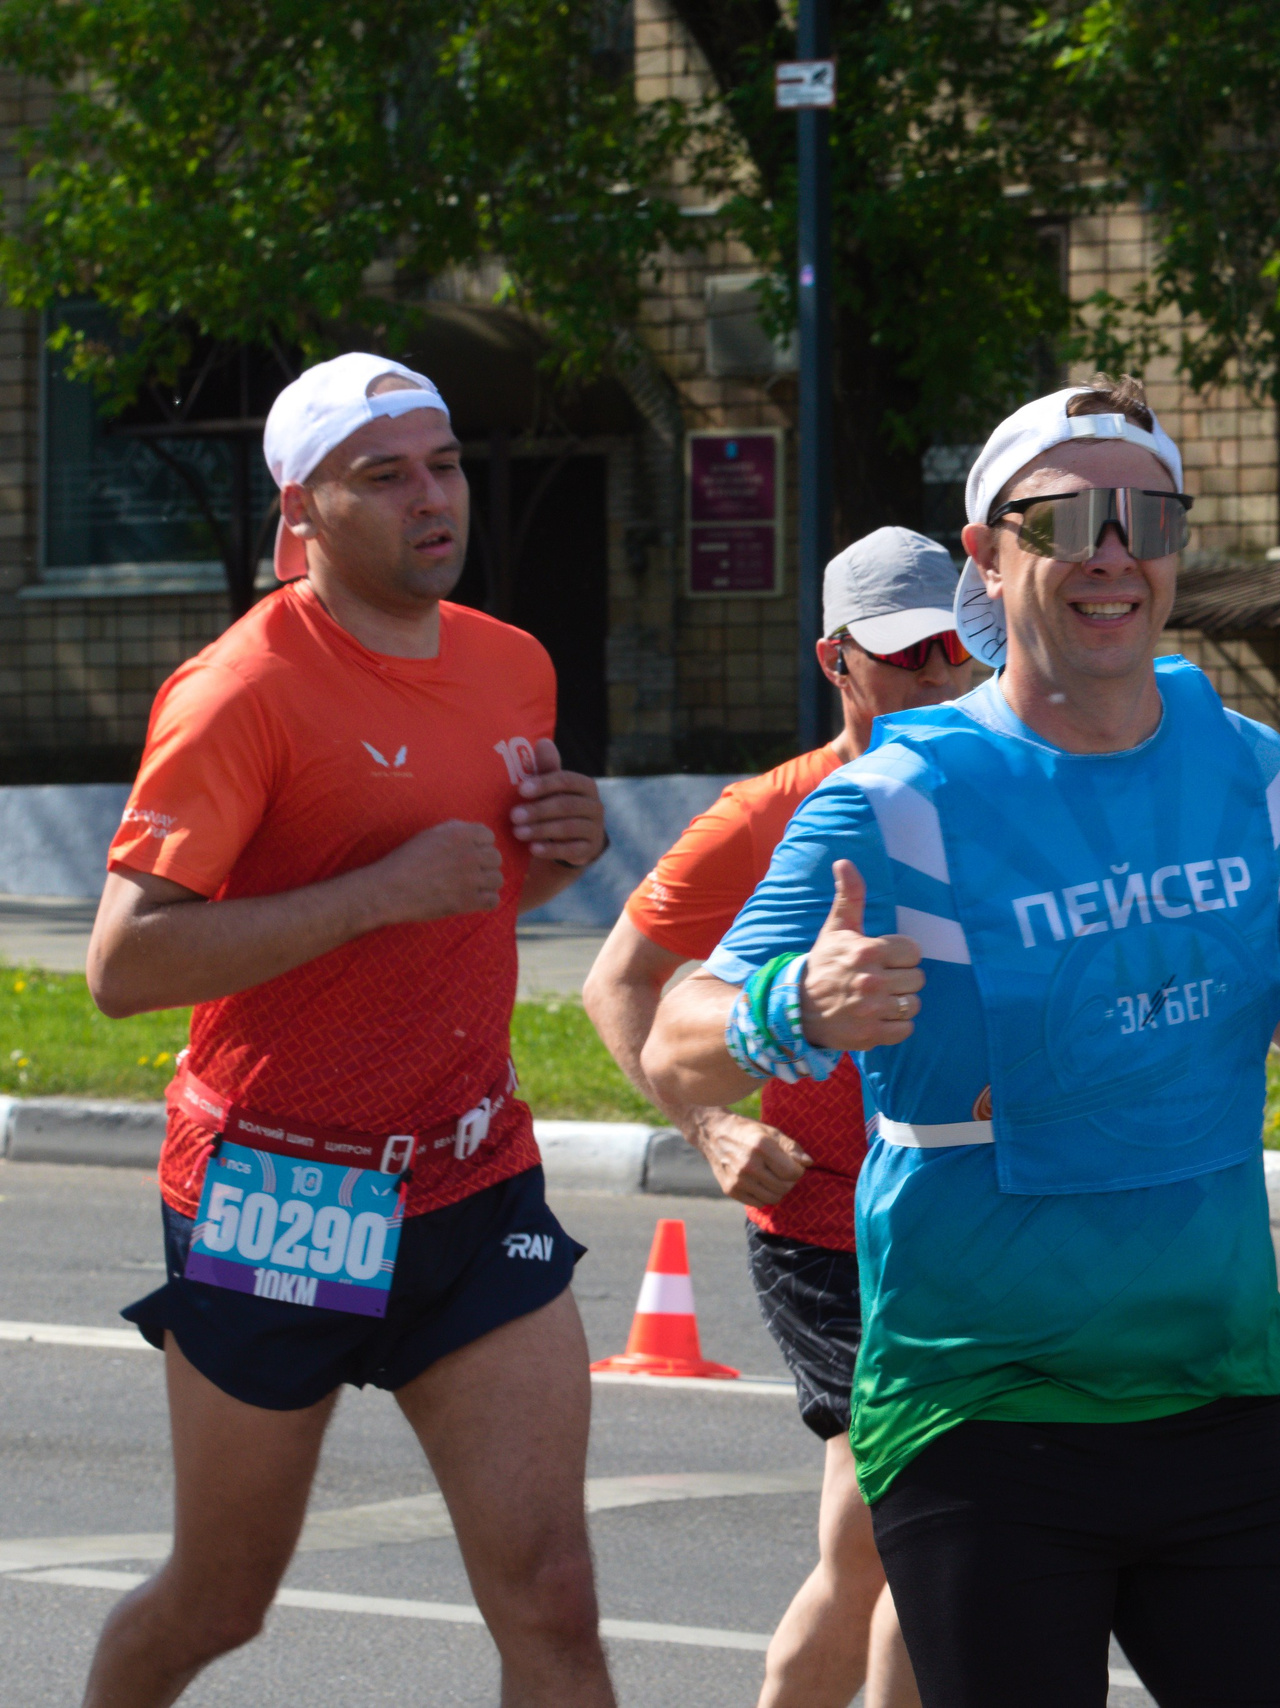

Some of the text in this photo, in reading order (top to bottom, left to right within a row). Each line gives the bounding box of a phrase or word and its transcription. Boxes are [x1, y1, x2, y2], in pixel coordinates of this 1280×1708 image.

[1011, 856, 1252, 949] ПЕЙСЕР
[227, 1158, 252, 1175] ПСБ
[291, 1165, 324, 1197] 10
[202, 1181, 388, 1280] 50290
